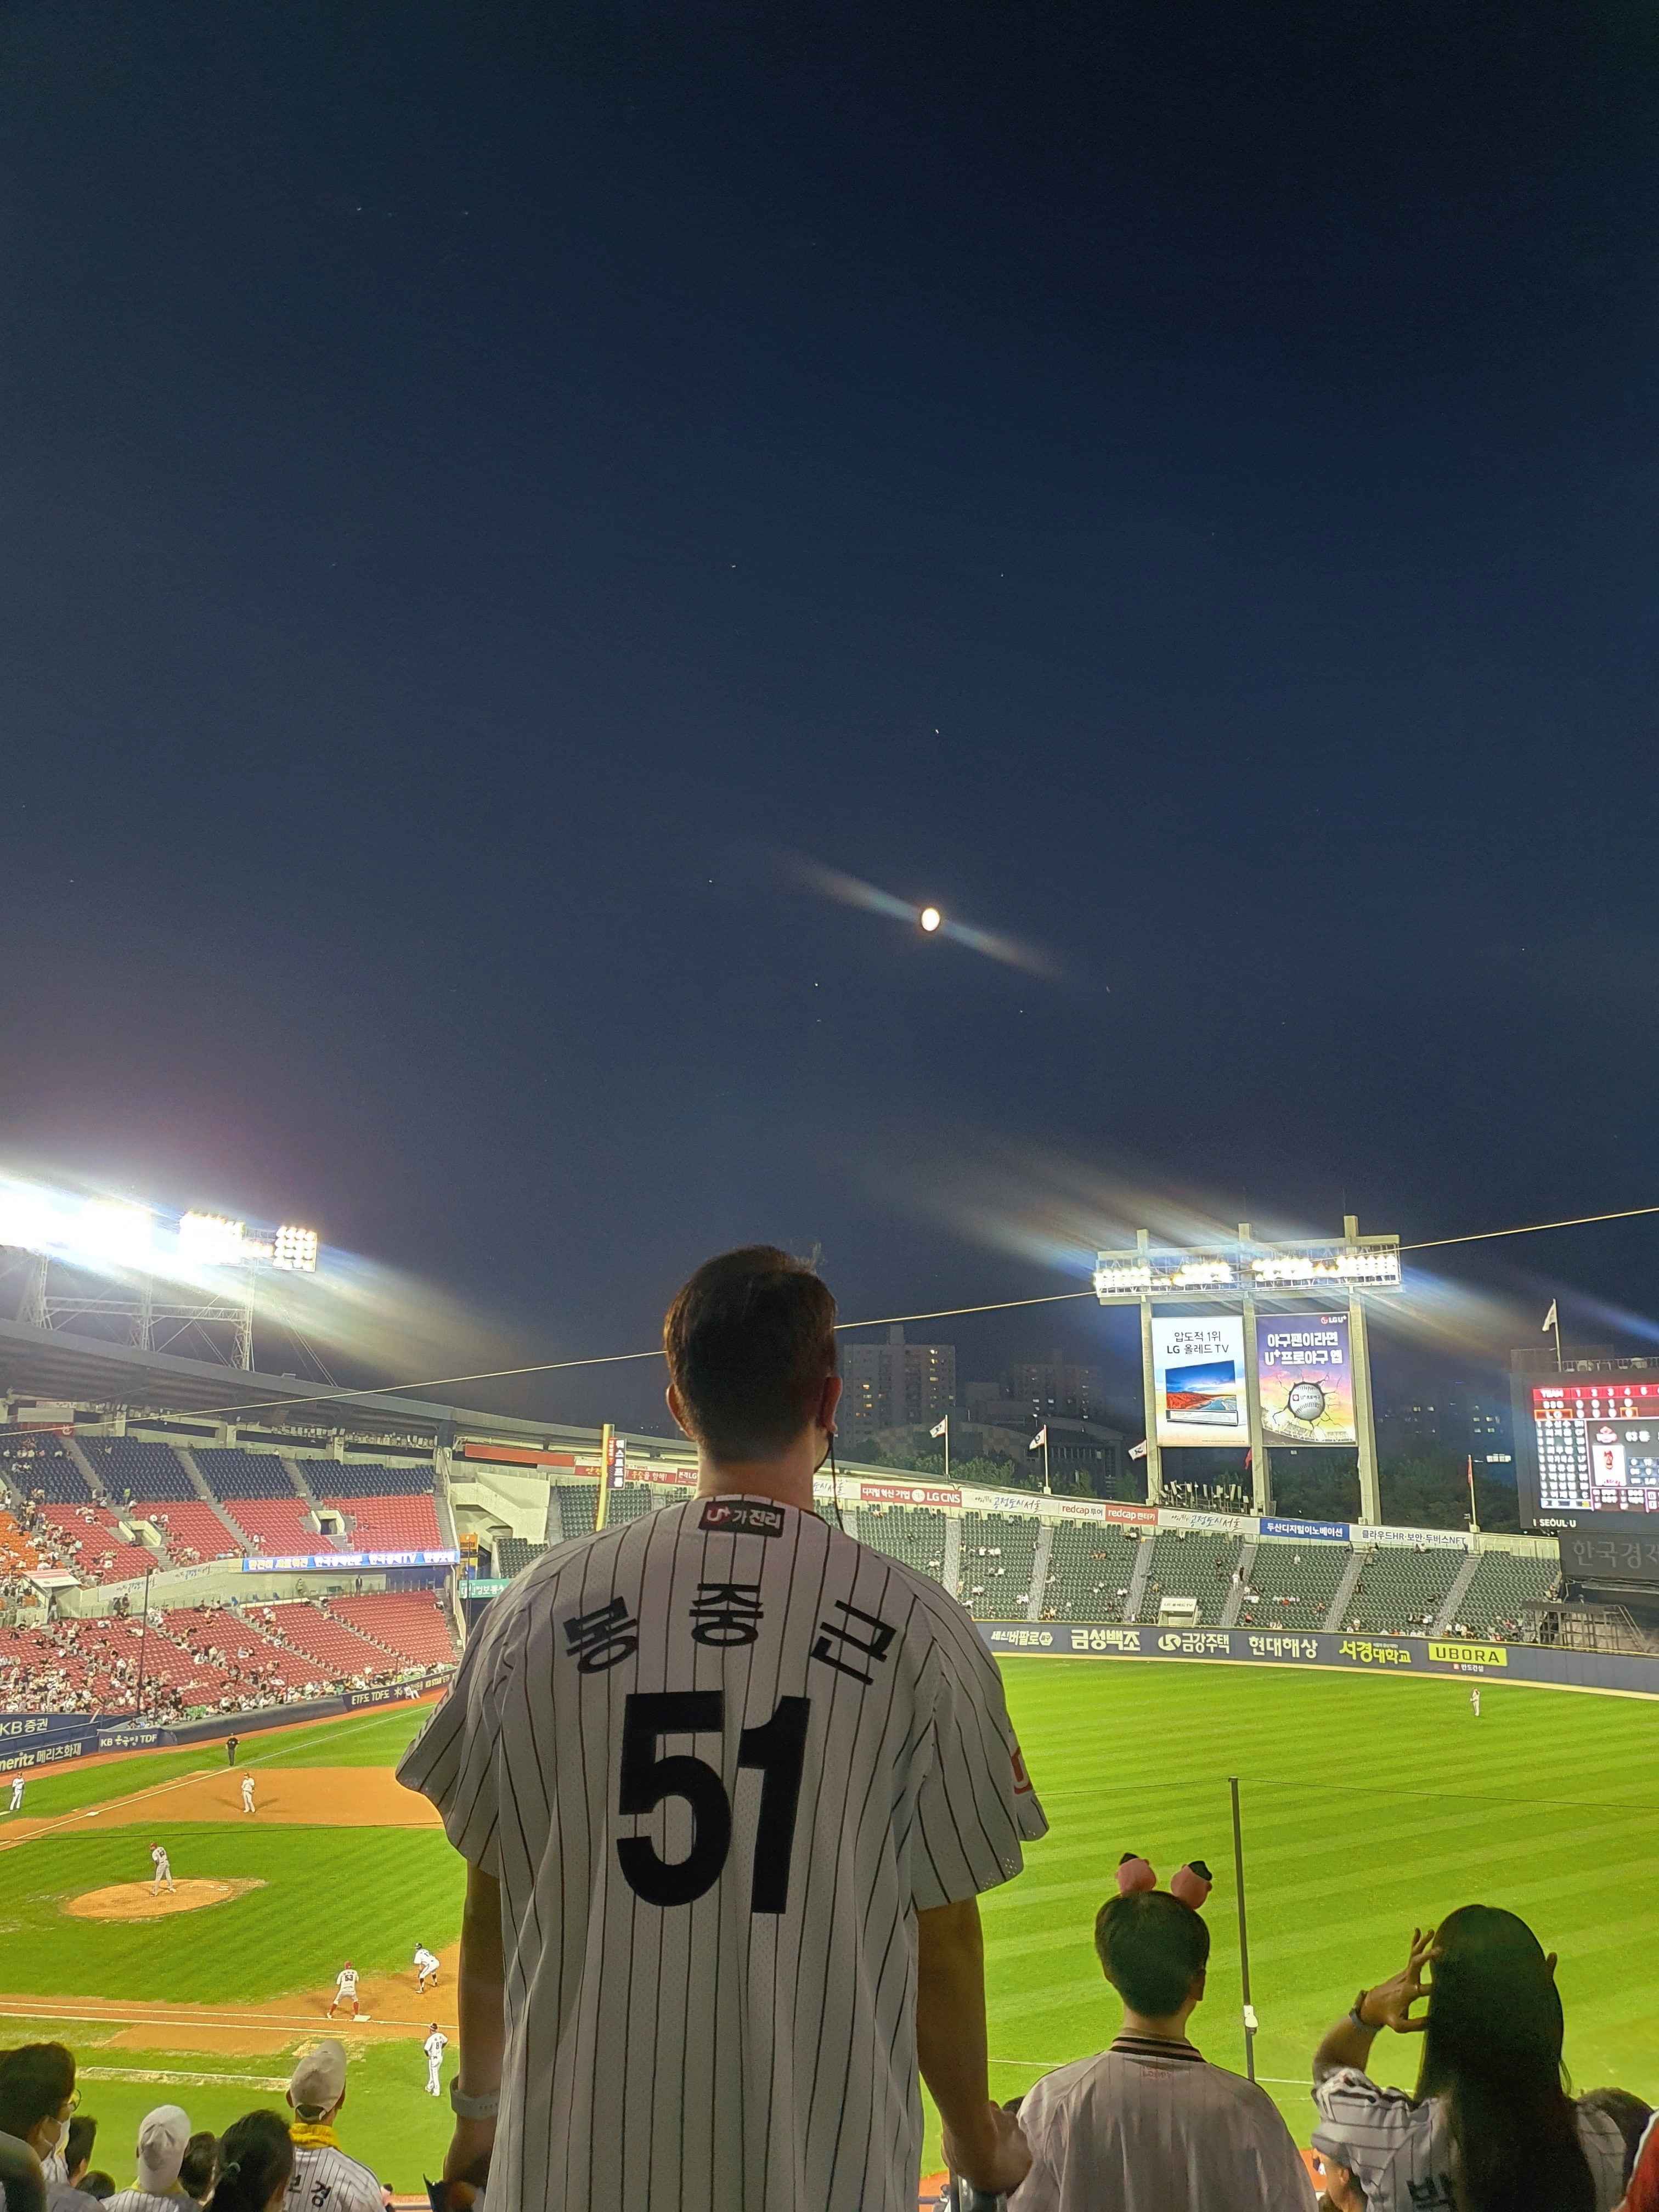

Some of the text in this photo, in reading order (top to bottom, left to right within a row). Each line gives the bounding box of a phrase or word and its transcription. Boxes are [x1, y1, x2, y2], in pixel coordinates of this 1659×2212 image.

[1174, 1331, 1221, 1342] 압도적 1위
[1267, 1331, 1339, 1347] 야구팬이라면
[1166, 1344, 1229, 1355] LG 올레드 TV
[631, 1470, 650, 1480] 우승을
[862, 1487, 960, 1503] 디지털 혁신 기업 LG CNS
[994, 1497, 1024, 1509] 공정도시
[1024, 1499, 1044, 1513] 서울
[1062, 1504, 1090, 1516] redcap
[1108, 1509, 1136, 1521] redcap
[1190, 1515, 1223, 1528] 공정도시
[1222, 1518, 1243, 1532] 서울
[1266, 1522, 1344, 1537] 두산디지털이노베이션
[991, 1630, 1040, 1646] 세신버팔로
[1071, 1629, 1141, 1651] 금성백조
[1182, 1633, 1229, 1654] 금강주택
[1249, 1636, 1318, 1659] 현대해상
[1339, 1640, 1412, 1664] 서경대학교
[1436, 1647, 1500, 1663] UBORA
[351, 1689, 390, 1705] ETF도 TDF도
[0, 1718, 48, 1736] KB 증권
[100, 1737, 113, 1747] KB
[140, 1733, 157, 1743] TDF
[36, 1742, 82, 1763] 메리츠화재
[617, 1690, 810, 1914] 51
